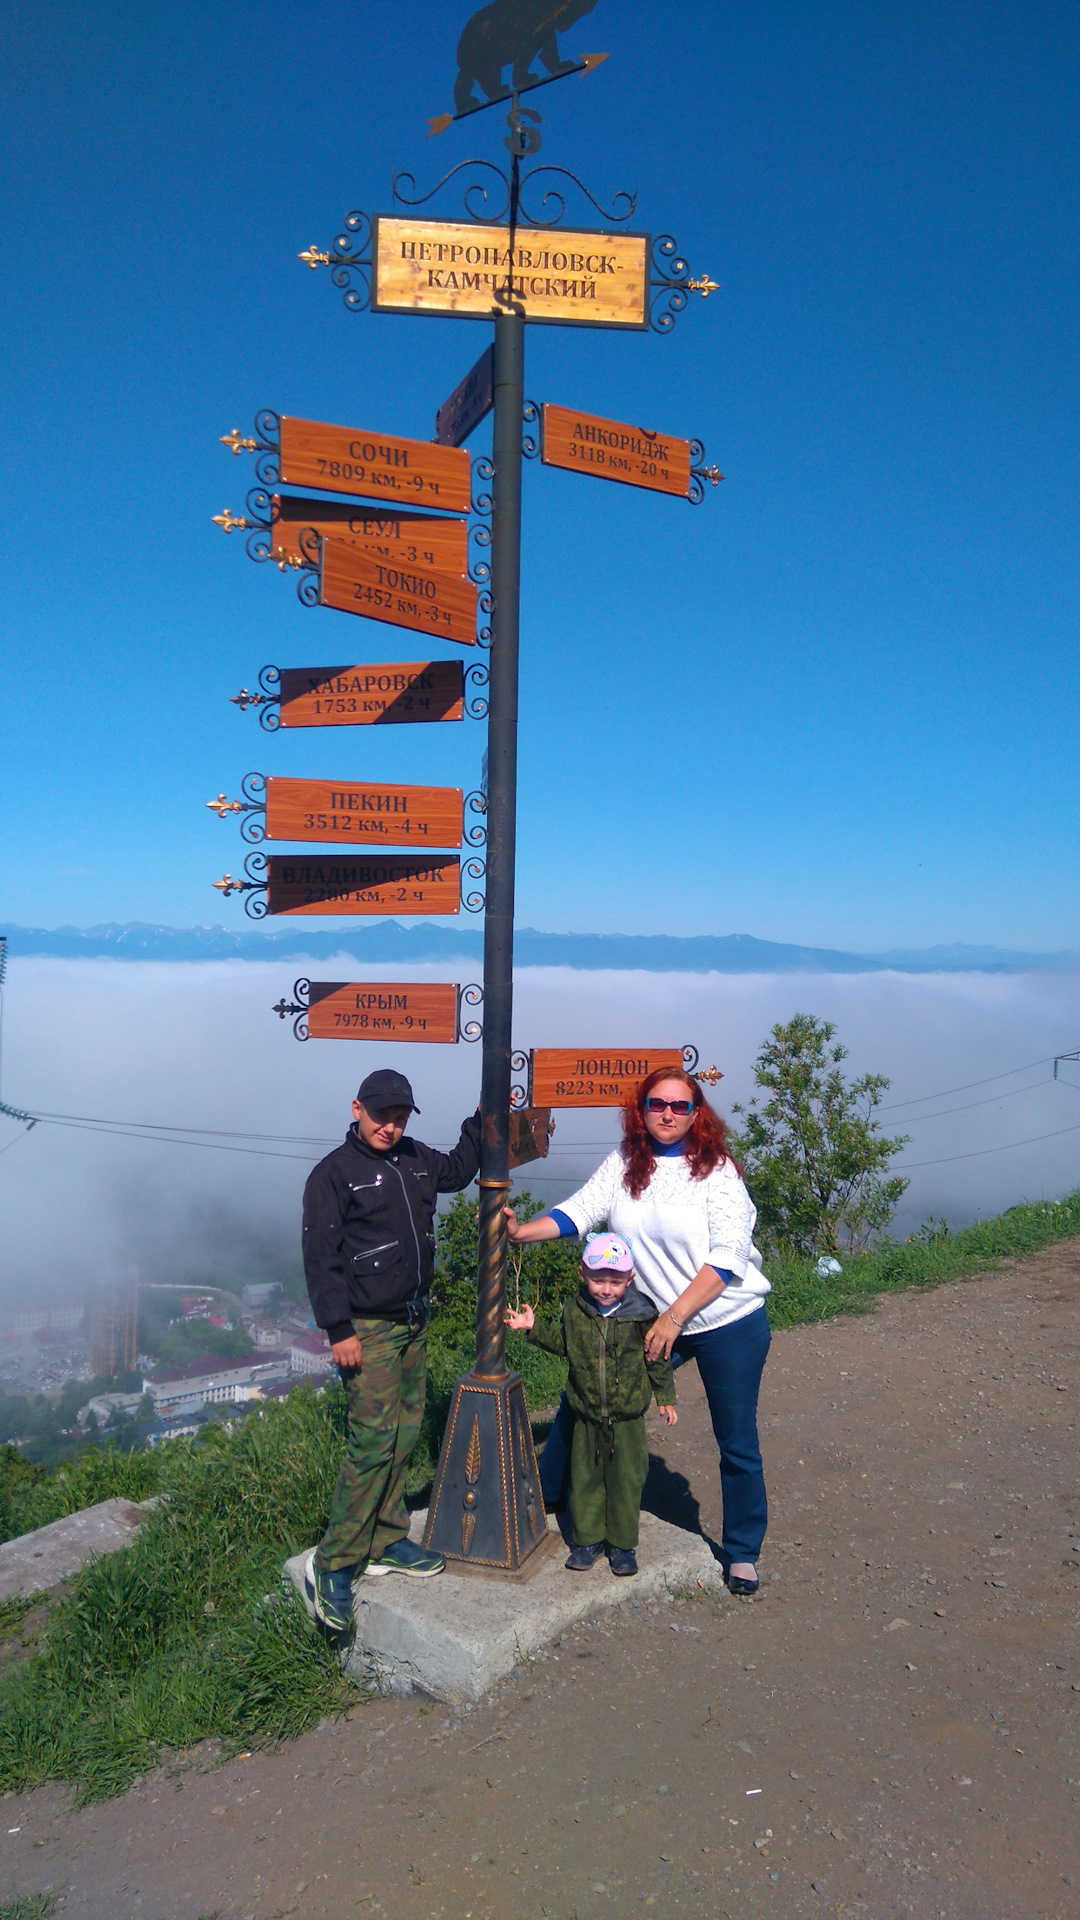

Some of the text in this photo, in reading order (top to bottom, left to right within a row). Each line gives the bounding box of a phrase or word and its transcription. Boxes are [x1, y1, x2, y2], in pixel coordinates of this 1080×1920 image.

[400, 241, 624, 274] ПЕТРОПАВЛОВСК-
[427, 269, 597, 299] КАМЧАТСКИЙ
[572, 422, 670, 461] АНКОРИДЖ
[348, 440, 408, 468] СОЧИ
[569, 443, 669, 480] 3118 км, -20 ч
[316, 459, 440, 495] 7809 км, -9 ч
[348, 516, 401, 539] СЕУЛ
[400, 546, 417, 562] -3
[423, 552, 434, 564] ч
[376, 565, 436, 599] ТОКИО
[353, 583, 451, 625] 2452 км, -3 ч
[307, 672, 435, 695] ХАБАРОВСК
[313, 696, 430, 714] 1753 км, -2 ч
[331, 792, 408, 813] ПЕКИН
[304, 814, 428, 834] 3512 км, -4 ч
[282, 866, 444, 885] ВЛАДИВОСТОК
[303, 886, 424, 904] 2280 км, -2 ч
[355, 993, 407, 1010] КРЫМ
[334, 1013, 426, 1030] 7978 км, -9 ч
[572, 1059, 649, 1078] ЛОНДОН
[555, 1081, 594, 1096] 8223
[599, 1082, 623, 1097] км,
